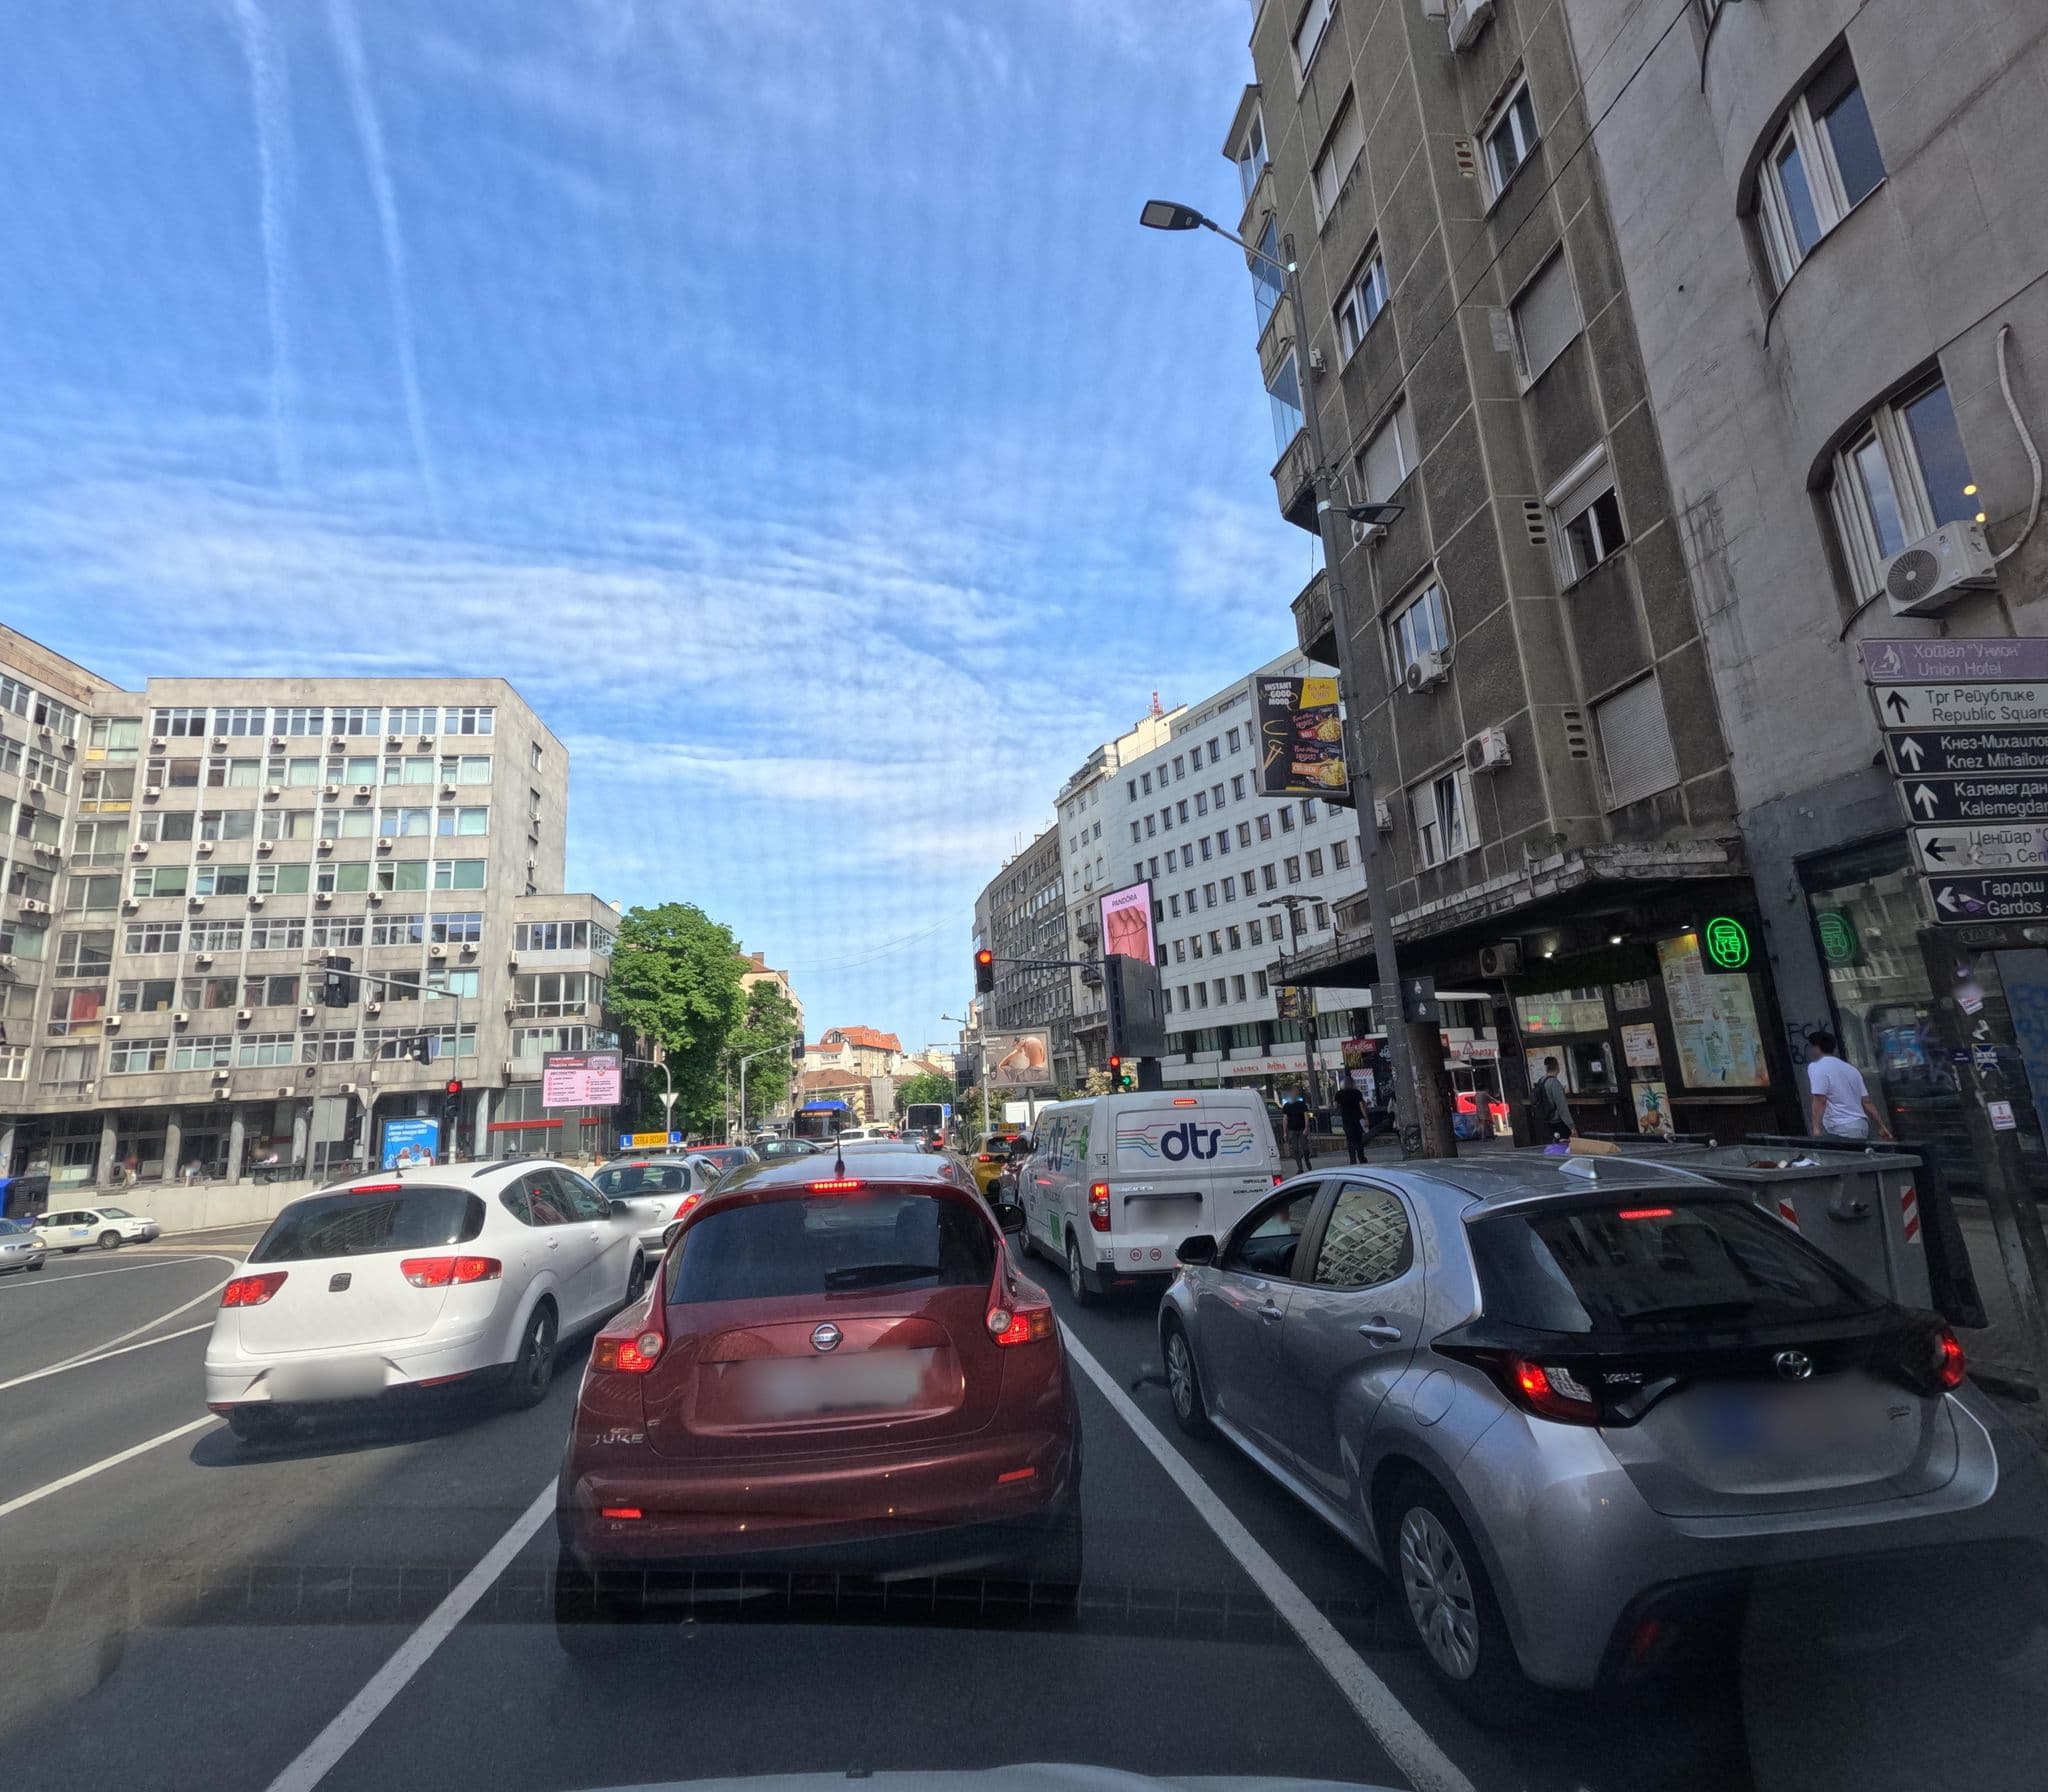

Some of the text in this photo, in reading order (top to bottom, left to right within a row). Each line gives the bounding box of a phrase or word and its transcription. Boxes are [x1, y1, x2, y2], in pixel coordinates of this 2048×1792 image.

[1917, 661, 2002, 677] Union Hotel
[1264, 682, 1293, 691] INSTANT
[1270, 690, 1292, 698] GOOD
[1268, 698, 1290, 706] MOOD
[1925, 689, 1950, 706] Трг
[1932, 705, 2048, 725] Republic Square
[1946, 754, 1984, 769] Knez
[1953, 782, 2048, 798] Калемегдан
[1981, 880, 2045, 898] Гардош
[1112, 894, 1137, 906] PANDORA
[1987, 900, 2042, 916] Gardos
[623, 1136, 631, 1146] L
[670, 1131, 678, 1143] L
[1160, 1122, 1222, 1161] dts
[588, 1433, 645, 1448] JUKE
